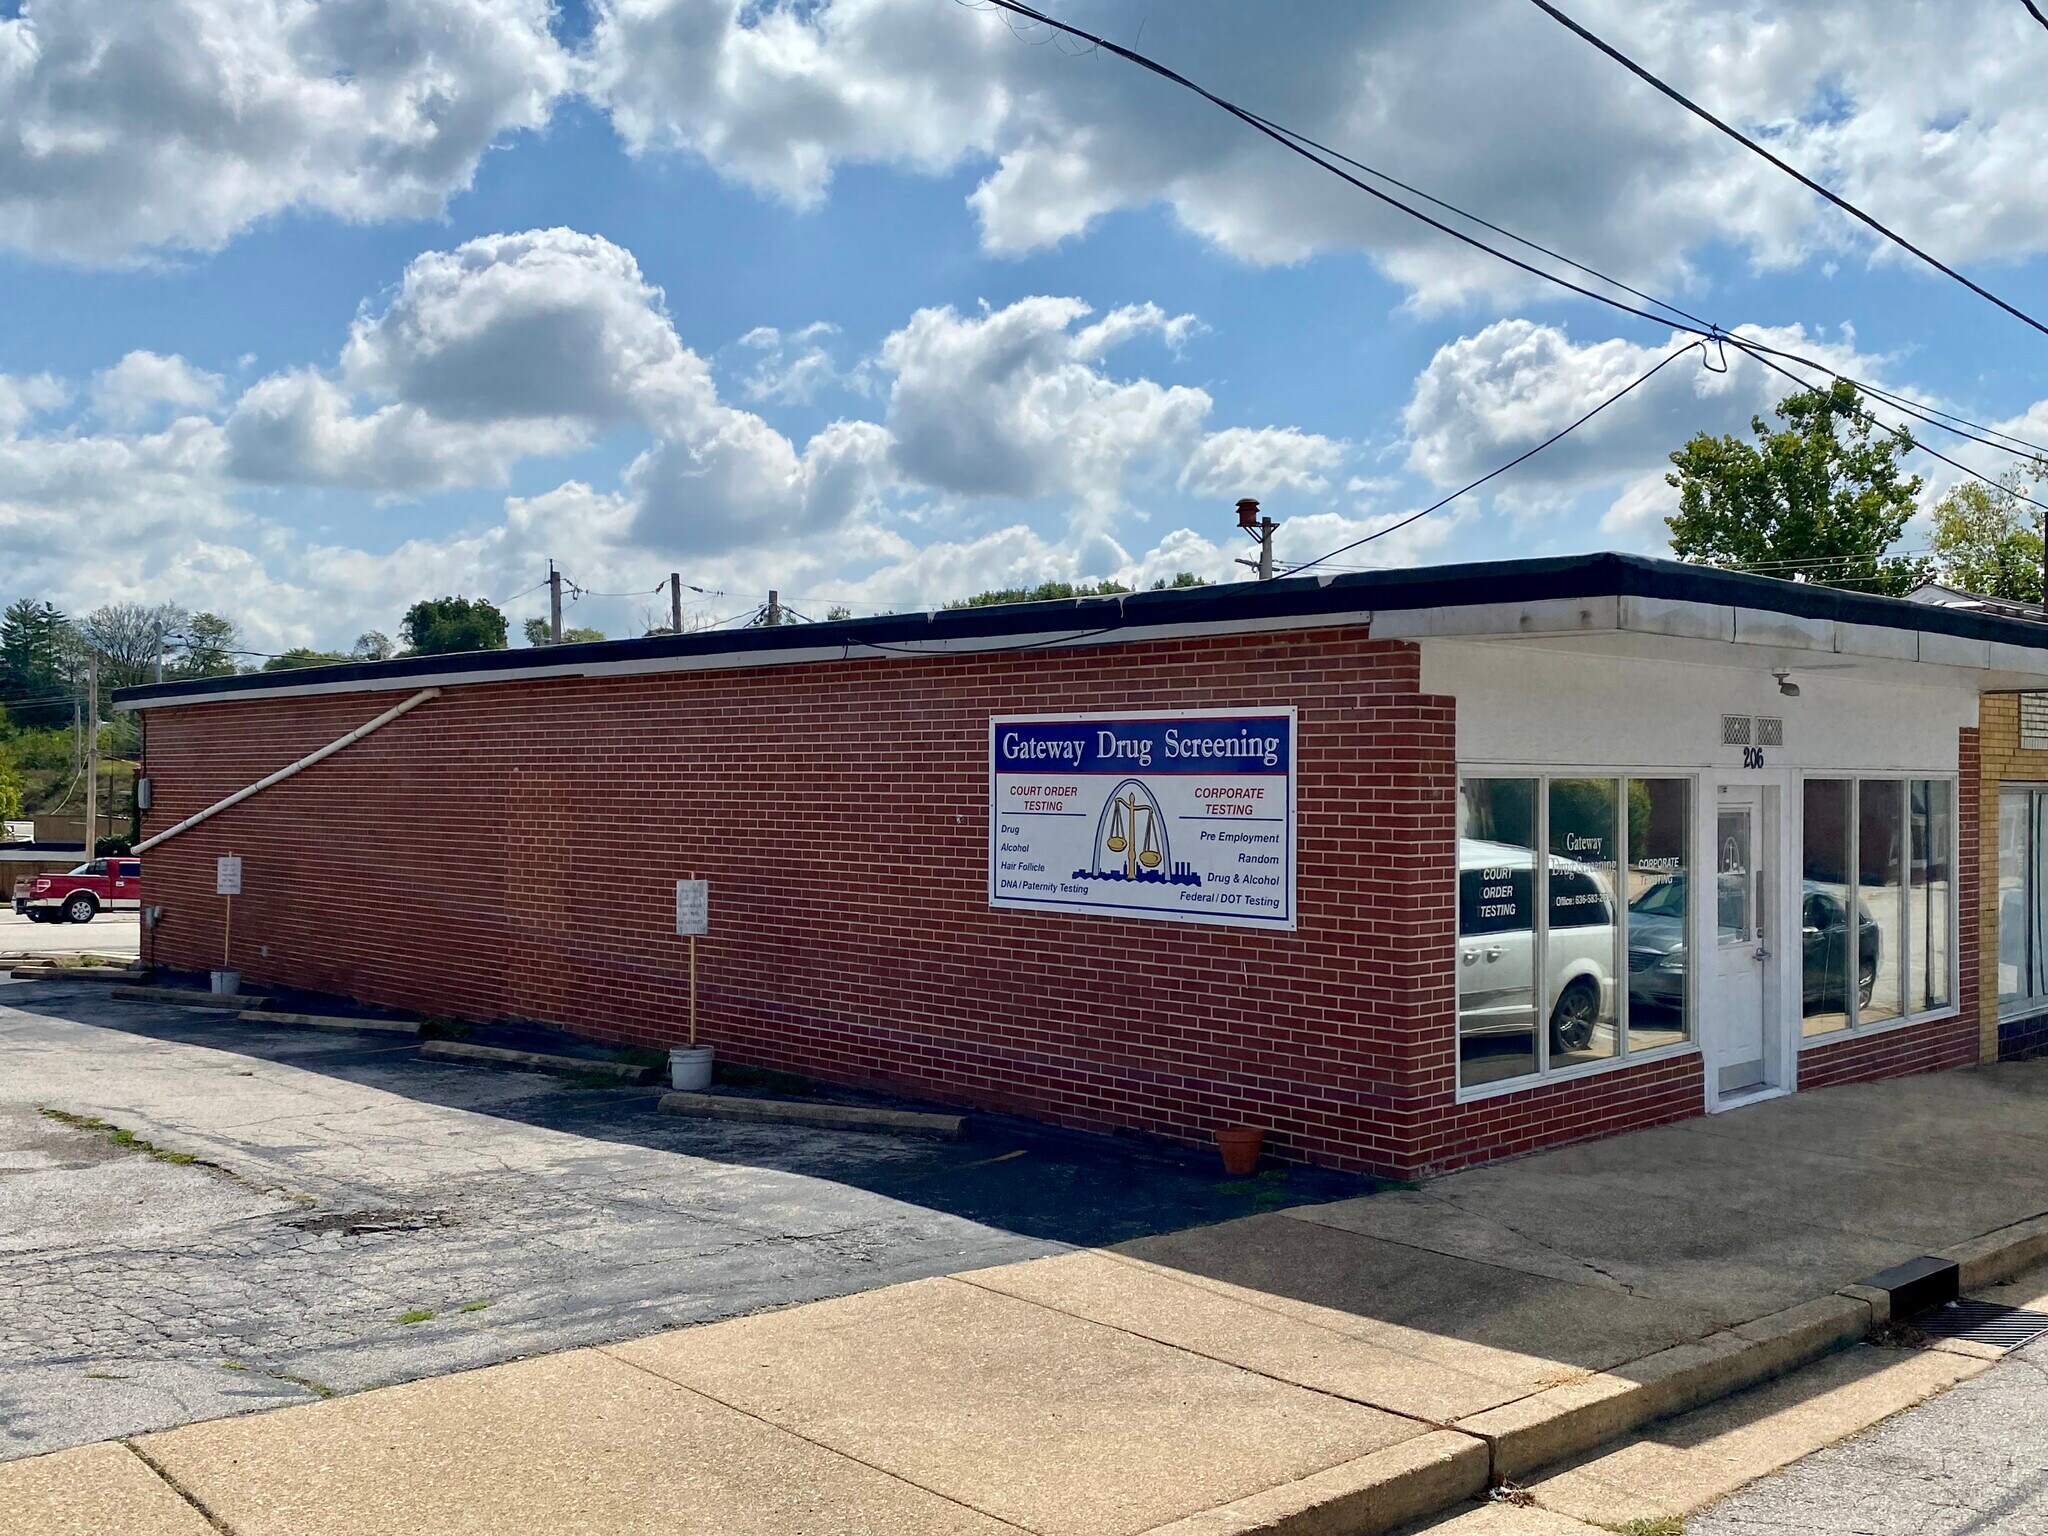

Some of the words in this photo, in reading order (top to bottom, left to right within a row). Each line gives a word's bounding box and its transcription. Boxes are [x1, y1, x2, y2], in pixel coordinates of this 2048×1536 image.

[1002, 732, 1085, 767] Gateway
[1096, 730, 1153, 766] Drug
[1165, 728, 1279, 766] Screening
[1743, 747, 1764, 769] 206
[1010, 785, 1042, 796] COURT
[1044, 786, 1078, 797] ORDER
[1194, 787, 1265, 799] CORPORATE
[1024, 800, 1063, 811] TESTING
[1205, 804, 1253, 815] TESTING
[1001, 824, 1020, 835] Drug
[1200, 831, 1216, 841] Pre
[1218, 831, 1280, 844] Employment
[1566, 832, 1603, 855] Gateway
[1000, 843, 1029, 852] Alcohol
[1238, 853, 1279, 864] Random
[1638, 856, 1680, 870] CORPORATE
[1000, 861, 1016, 870] Hair
[1018, 861, 1045, 872] Follicle
[1207, 872, 1231, 885] Drug
[1233, 873, 1240, 884] &
[1242, 874, 1280, 886] Alcohol
[1483, 867, 1512, 880] COURT
[1060, 883, 1089, 895] Testing
[1483, 885, 1514, 899] ORDER
[1244, 895, 1280, 909] Testing
[1480, 903, 1516, 918] TESTING
